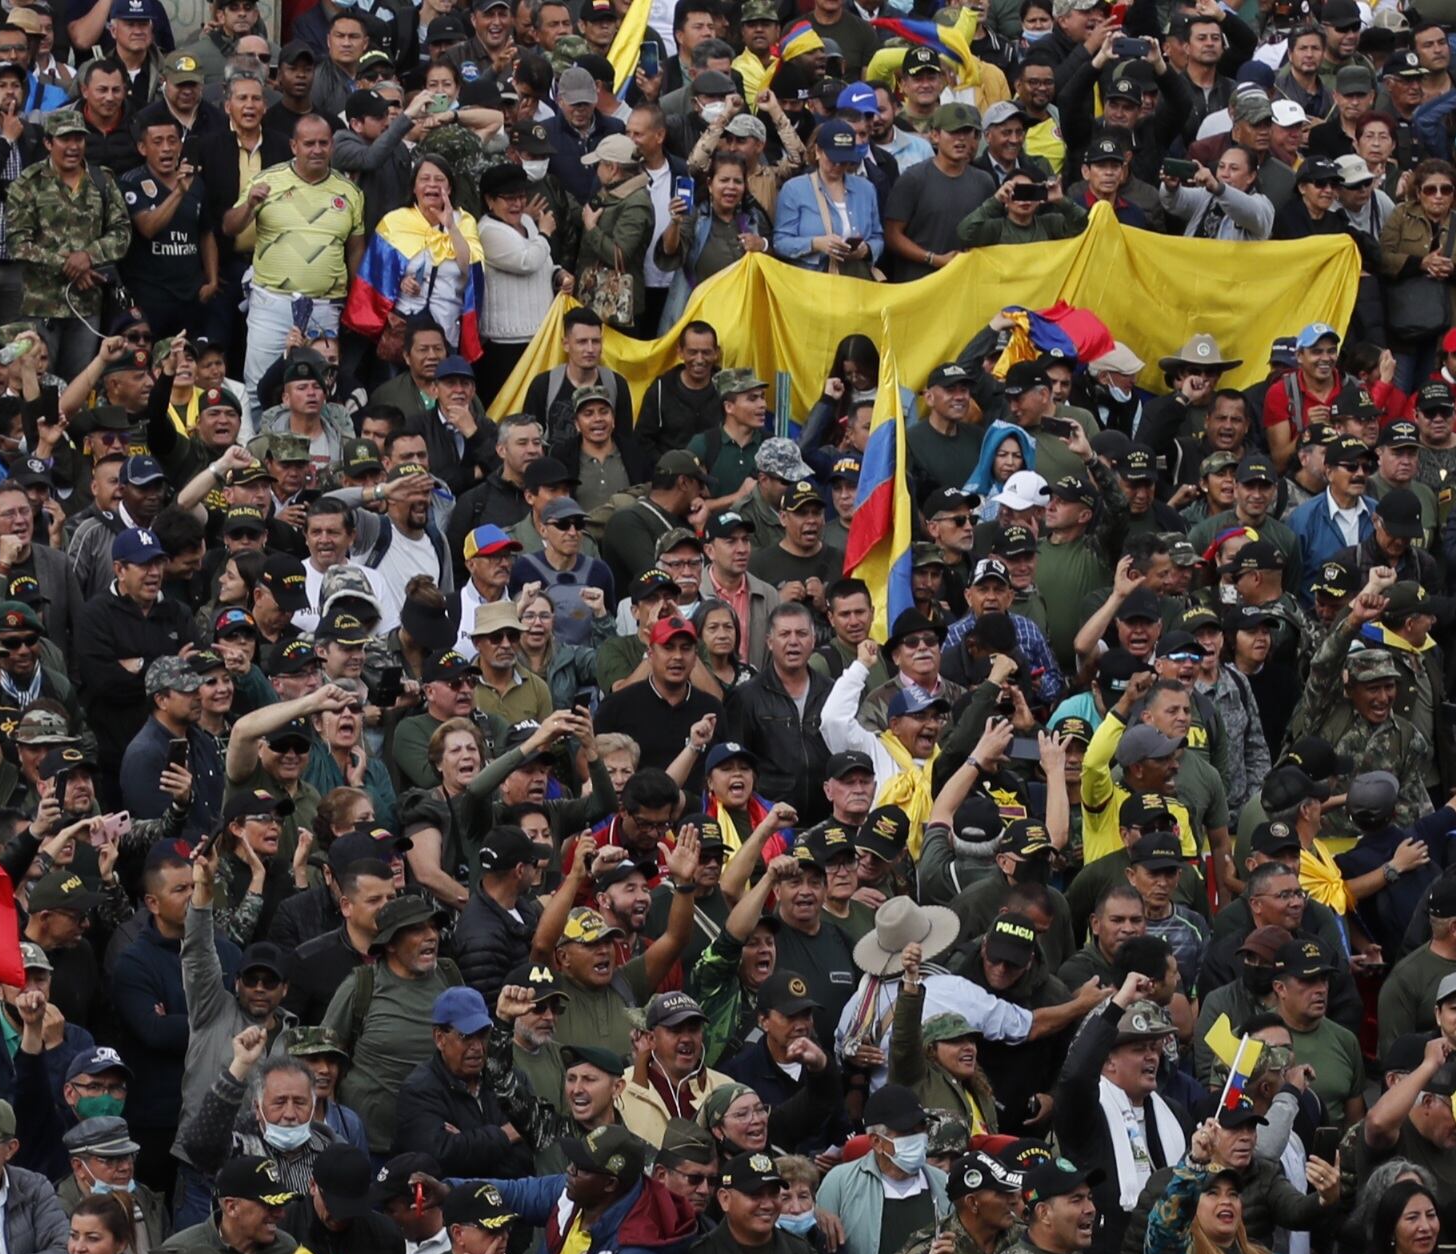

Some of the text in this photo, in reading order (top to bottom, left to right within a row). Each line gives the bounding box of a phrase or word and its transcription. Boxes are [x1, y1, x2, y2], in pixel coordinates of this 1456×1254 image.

[171, 231, 188, 243] Fly
[152, 241, 198, 256] Emirates
[137, 529, 153, 546] LA
[61, 875, 82, 893] POLI
[996, 922, 1035, 942] POLICIA
[529, 966, 554, 983] 44
[1017, 1147, 1052, 1162] VETERANO
